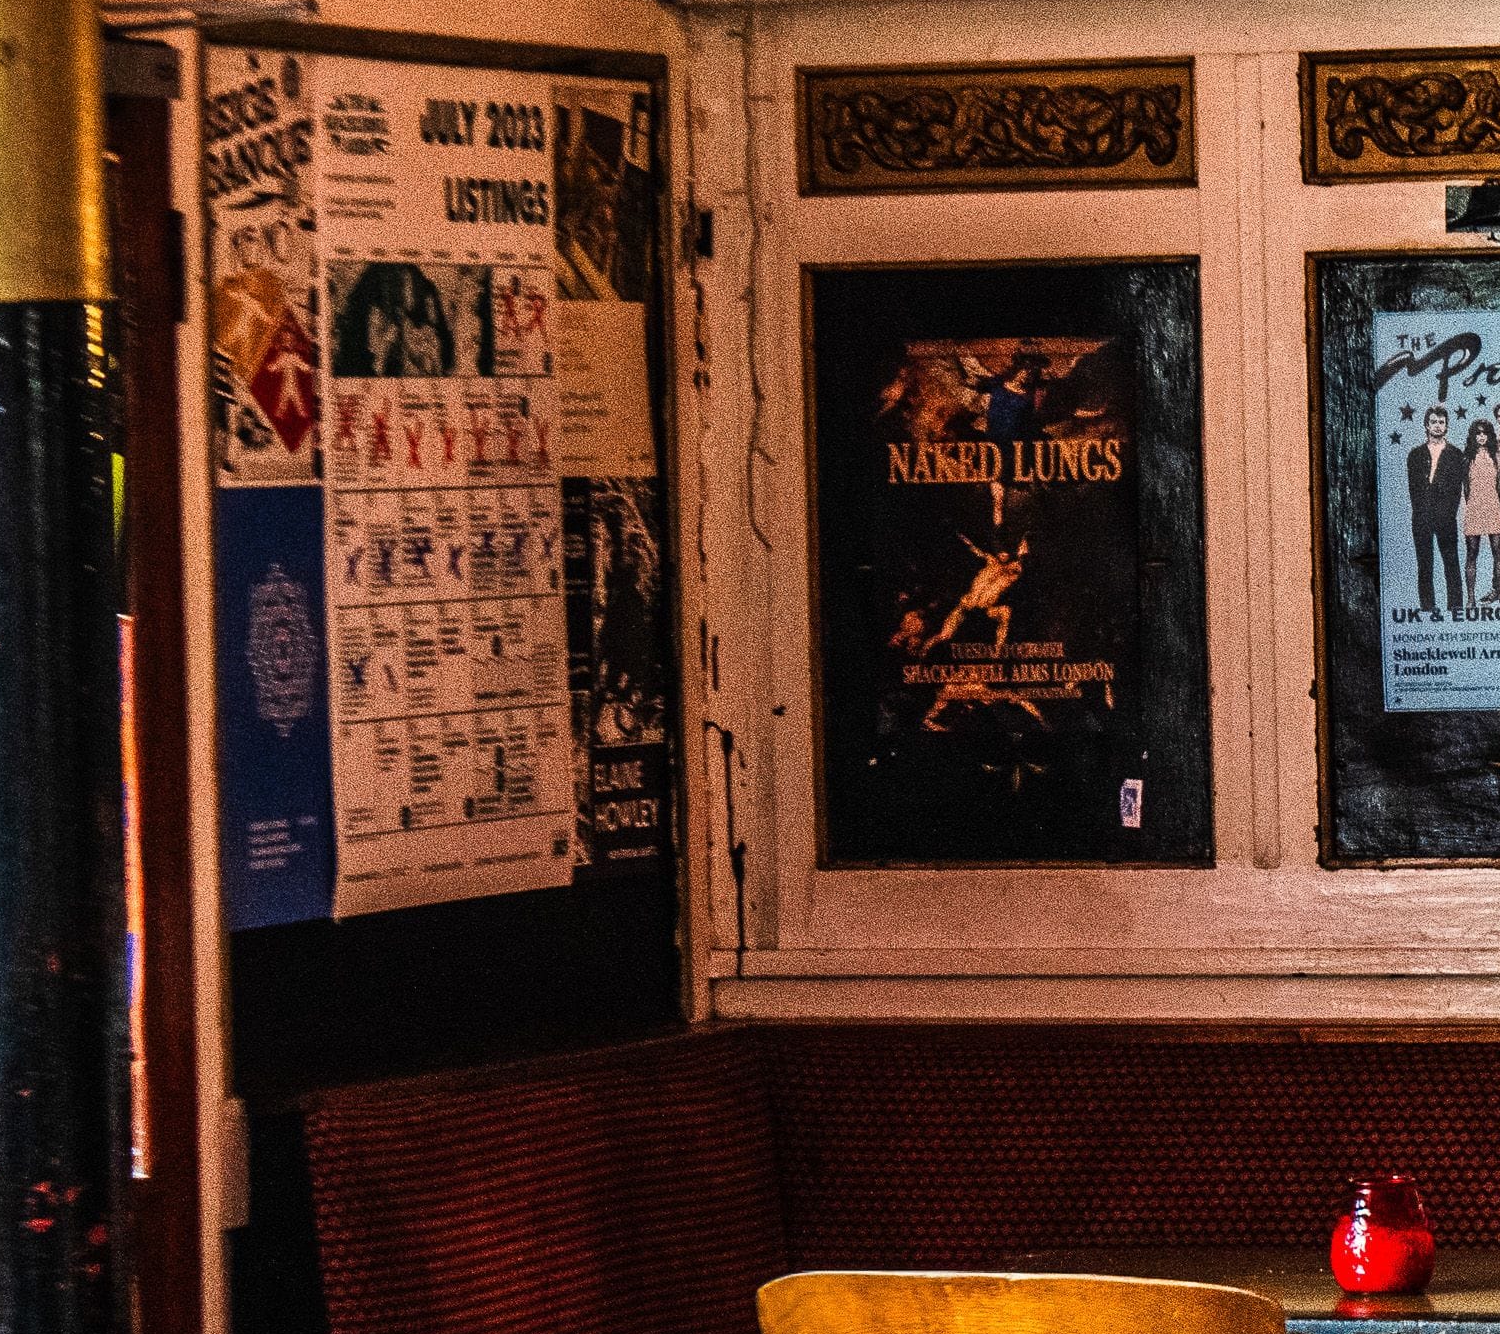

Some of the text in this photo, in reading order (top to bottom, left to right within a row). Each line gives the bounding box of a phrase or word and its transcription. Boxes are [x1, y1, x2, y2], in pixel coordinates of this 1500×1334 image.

[421, 99, 479, 145] JULY
[487, 102, 545, 152] 2023
[445, 175, 547, 226] LISTINGS
[1396, 333, 1436, 351] THE
[888, 440, 1123, 485] NAKED LUNGS
[1392, 607, 1421, 624] UK
[1430, 606, 1444, 623] &
[1393, 632, 1435, 644] MONDAY
[1393, 646, 1476, 662] Shacklewell
[902, 661, 1115, 684] SHACKLEWELL ARMS LONDON
[1394, 662, 1448, 676] London
